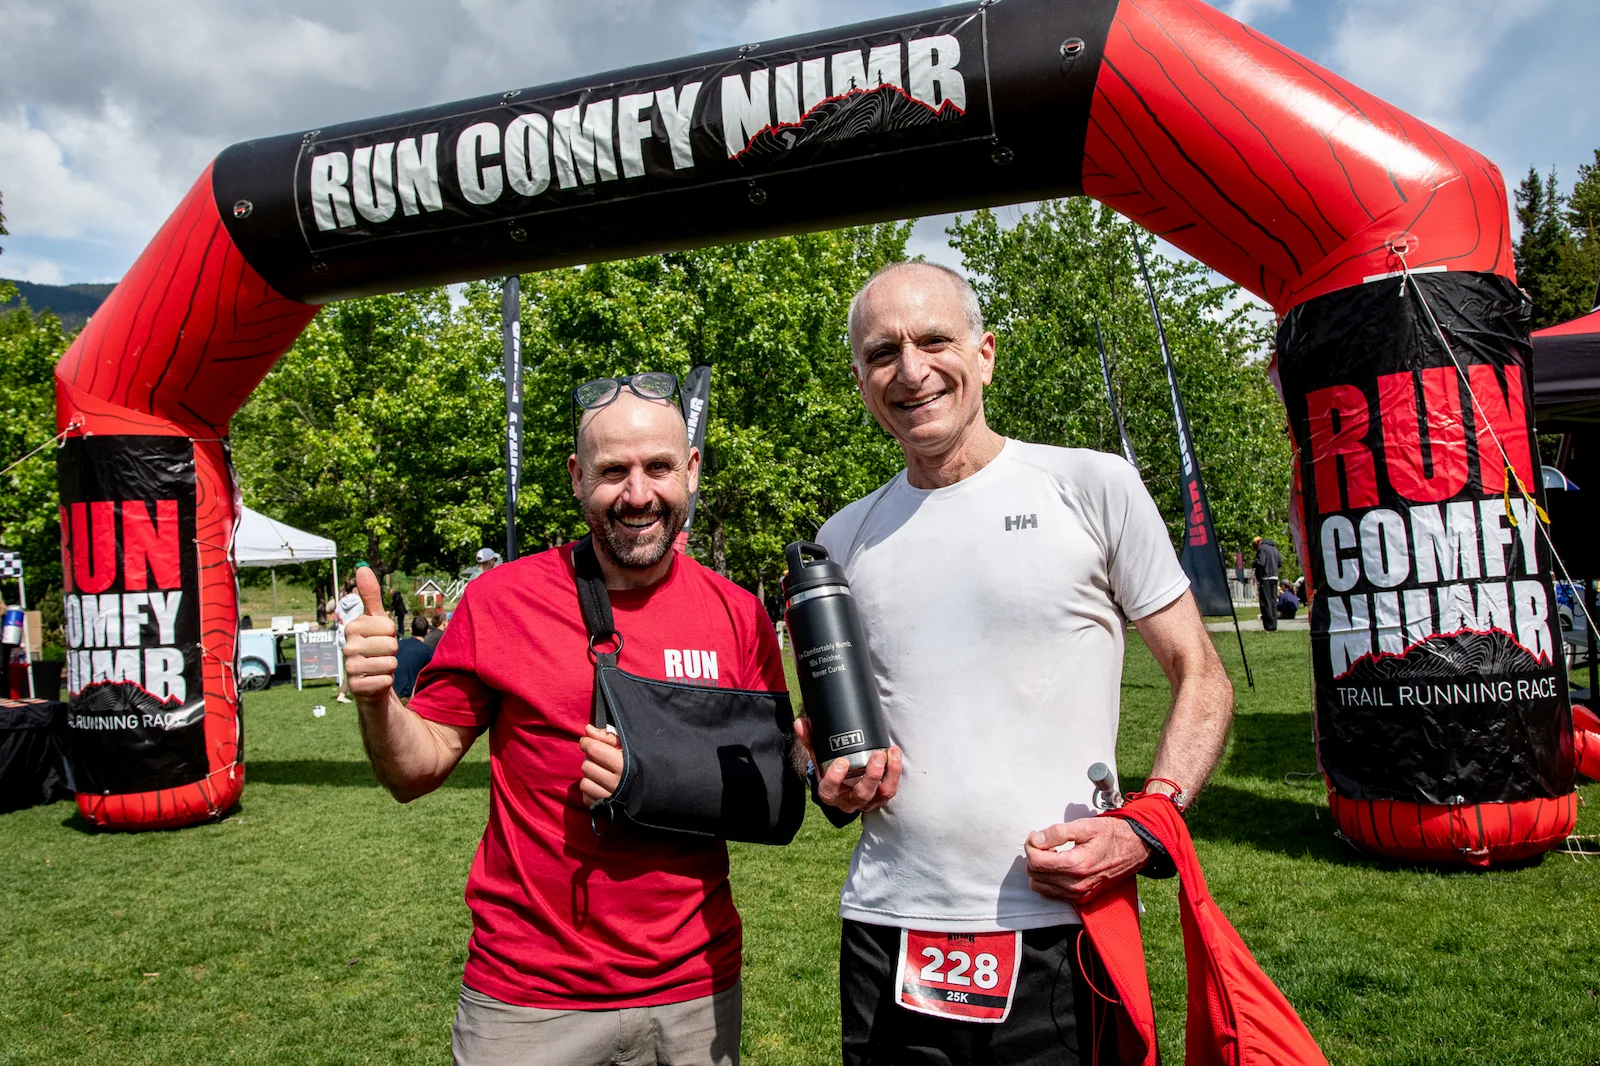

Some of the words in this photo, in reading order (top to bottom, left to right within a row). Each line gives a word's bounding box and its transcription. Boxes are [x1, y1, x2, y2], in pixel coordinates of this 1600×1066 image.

[311, 132, 443, 232] RUN
[456, 82, 702, 206] COMFY
[721, 34, 966, 160] NUMB
[1306, 364, 1535, 515] RUN
[1320, 498, 1538, 592] COMFY
[64, 591, 183, 648] OMFY
[1327, 580, 1553, 680] NUMB
[664, 649, 718, 680] RUN
[803, 642, 835, 658] Comfortably
[812, 668, 828, 679] Never
[1337, 687, 1393, 707] TRAIL
[1399, 681, 1513, 706] RUNNING
[1517, 676, 1557, 700] RACE
[76, 714, 139, 730] RUNNING
[832, 732, 862, 748] YETI
[920, 946, 999, 990] 228
[946, 990, 969, 1003] 25K
